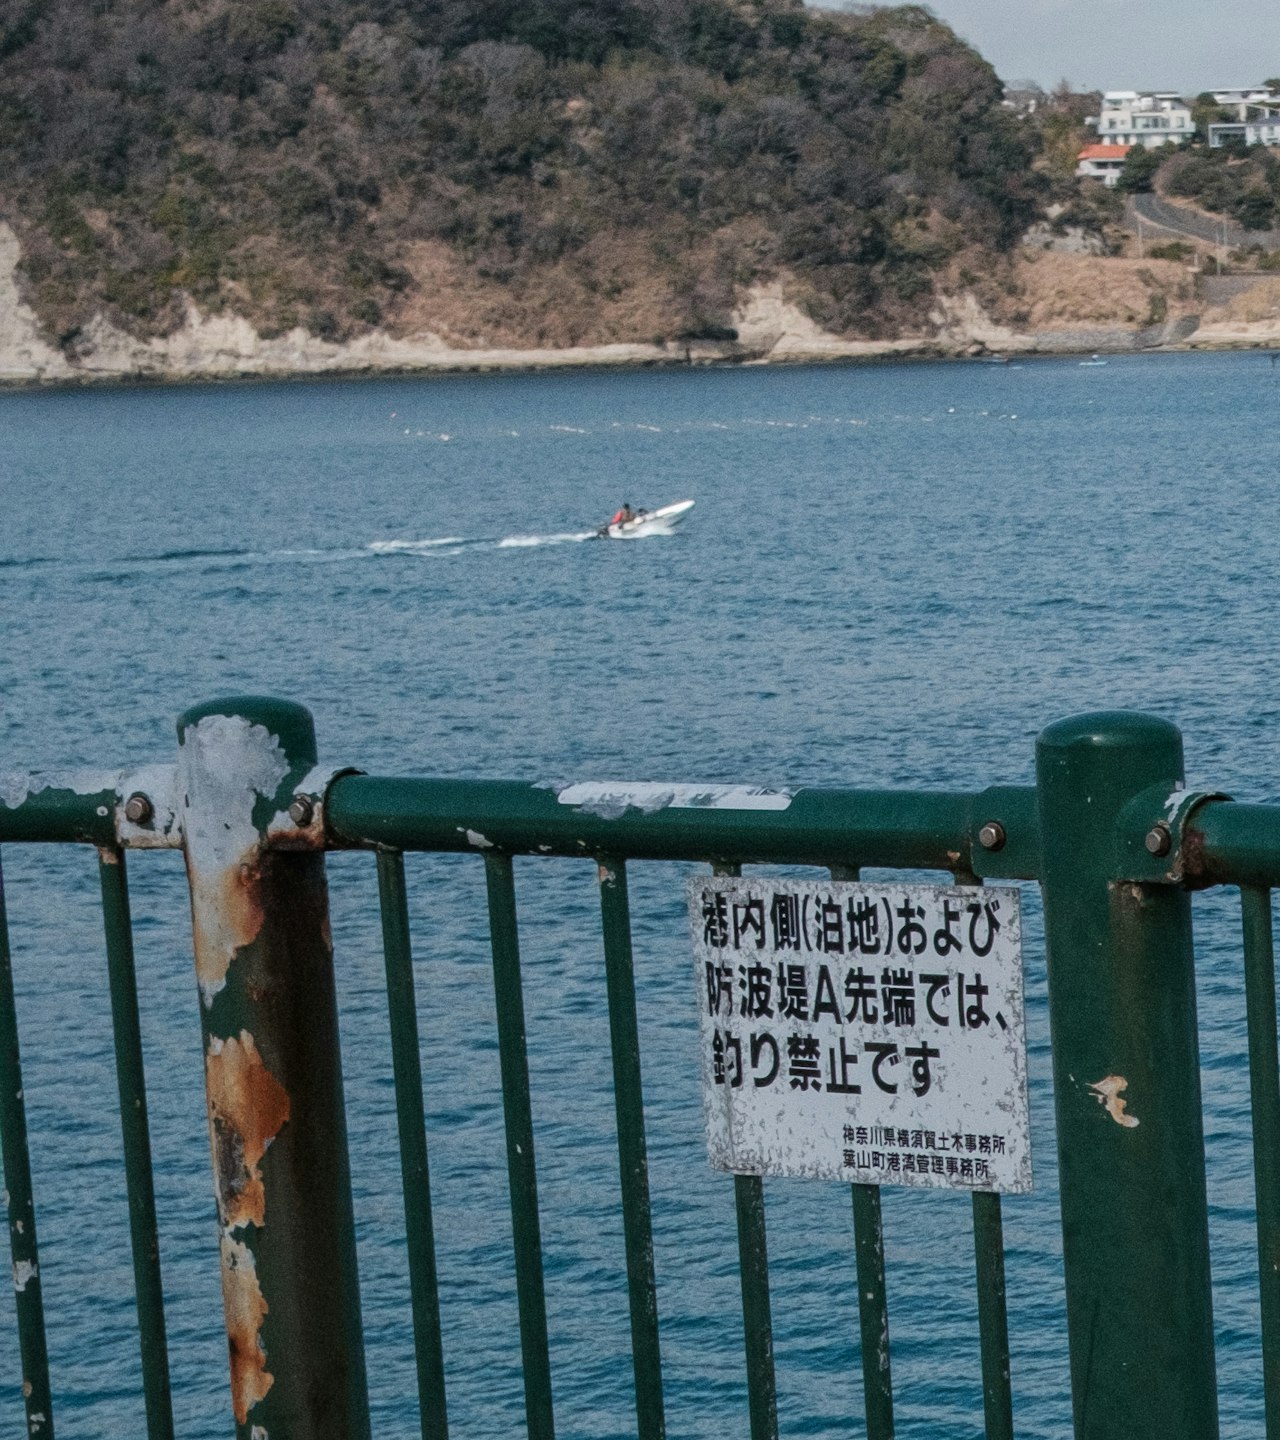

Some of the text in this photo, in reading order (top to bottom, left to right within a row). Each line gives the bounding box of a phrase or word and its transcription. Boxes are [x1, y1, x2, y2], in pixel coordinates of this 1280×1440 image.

[702, 891, 1001, 957] 港内側(泊地)および
[705, 961, 1008, 1030] 防波堤A先端では、
[712, 1028, 941, 1098] 釣り禁止です
[842, 1123, 1006, 1156] 神奈川県横須賀土木事務所
[842, 1148, 990, 1179] 葉山町港湾管理事務所
